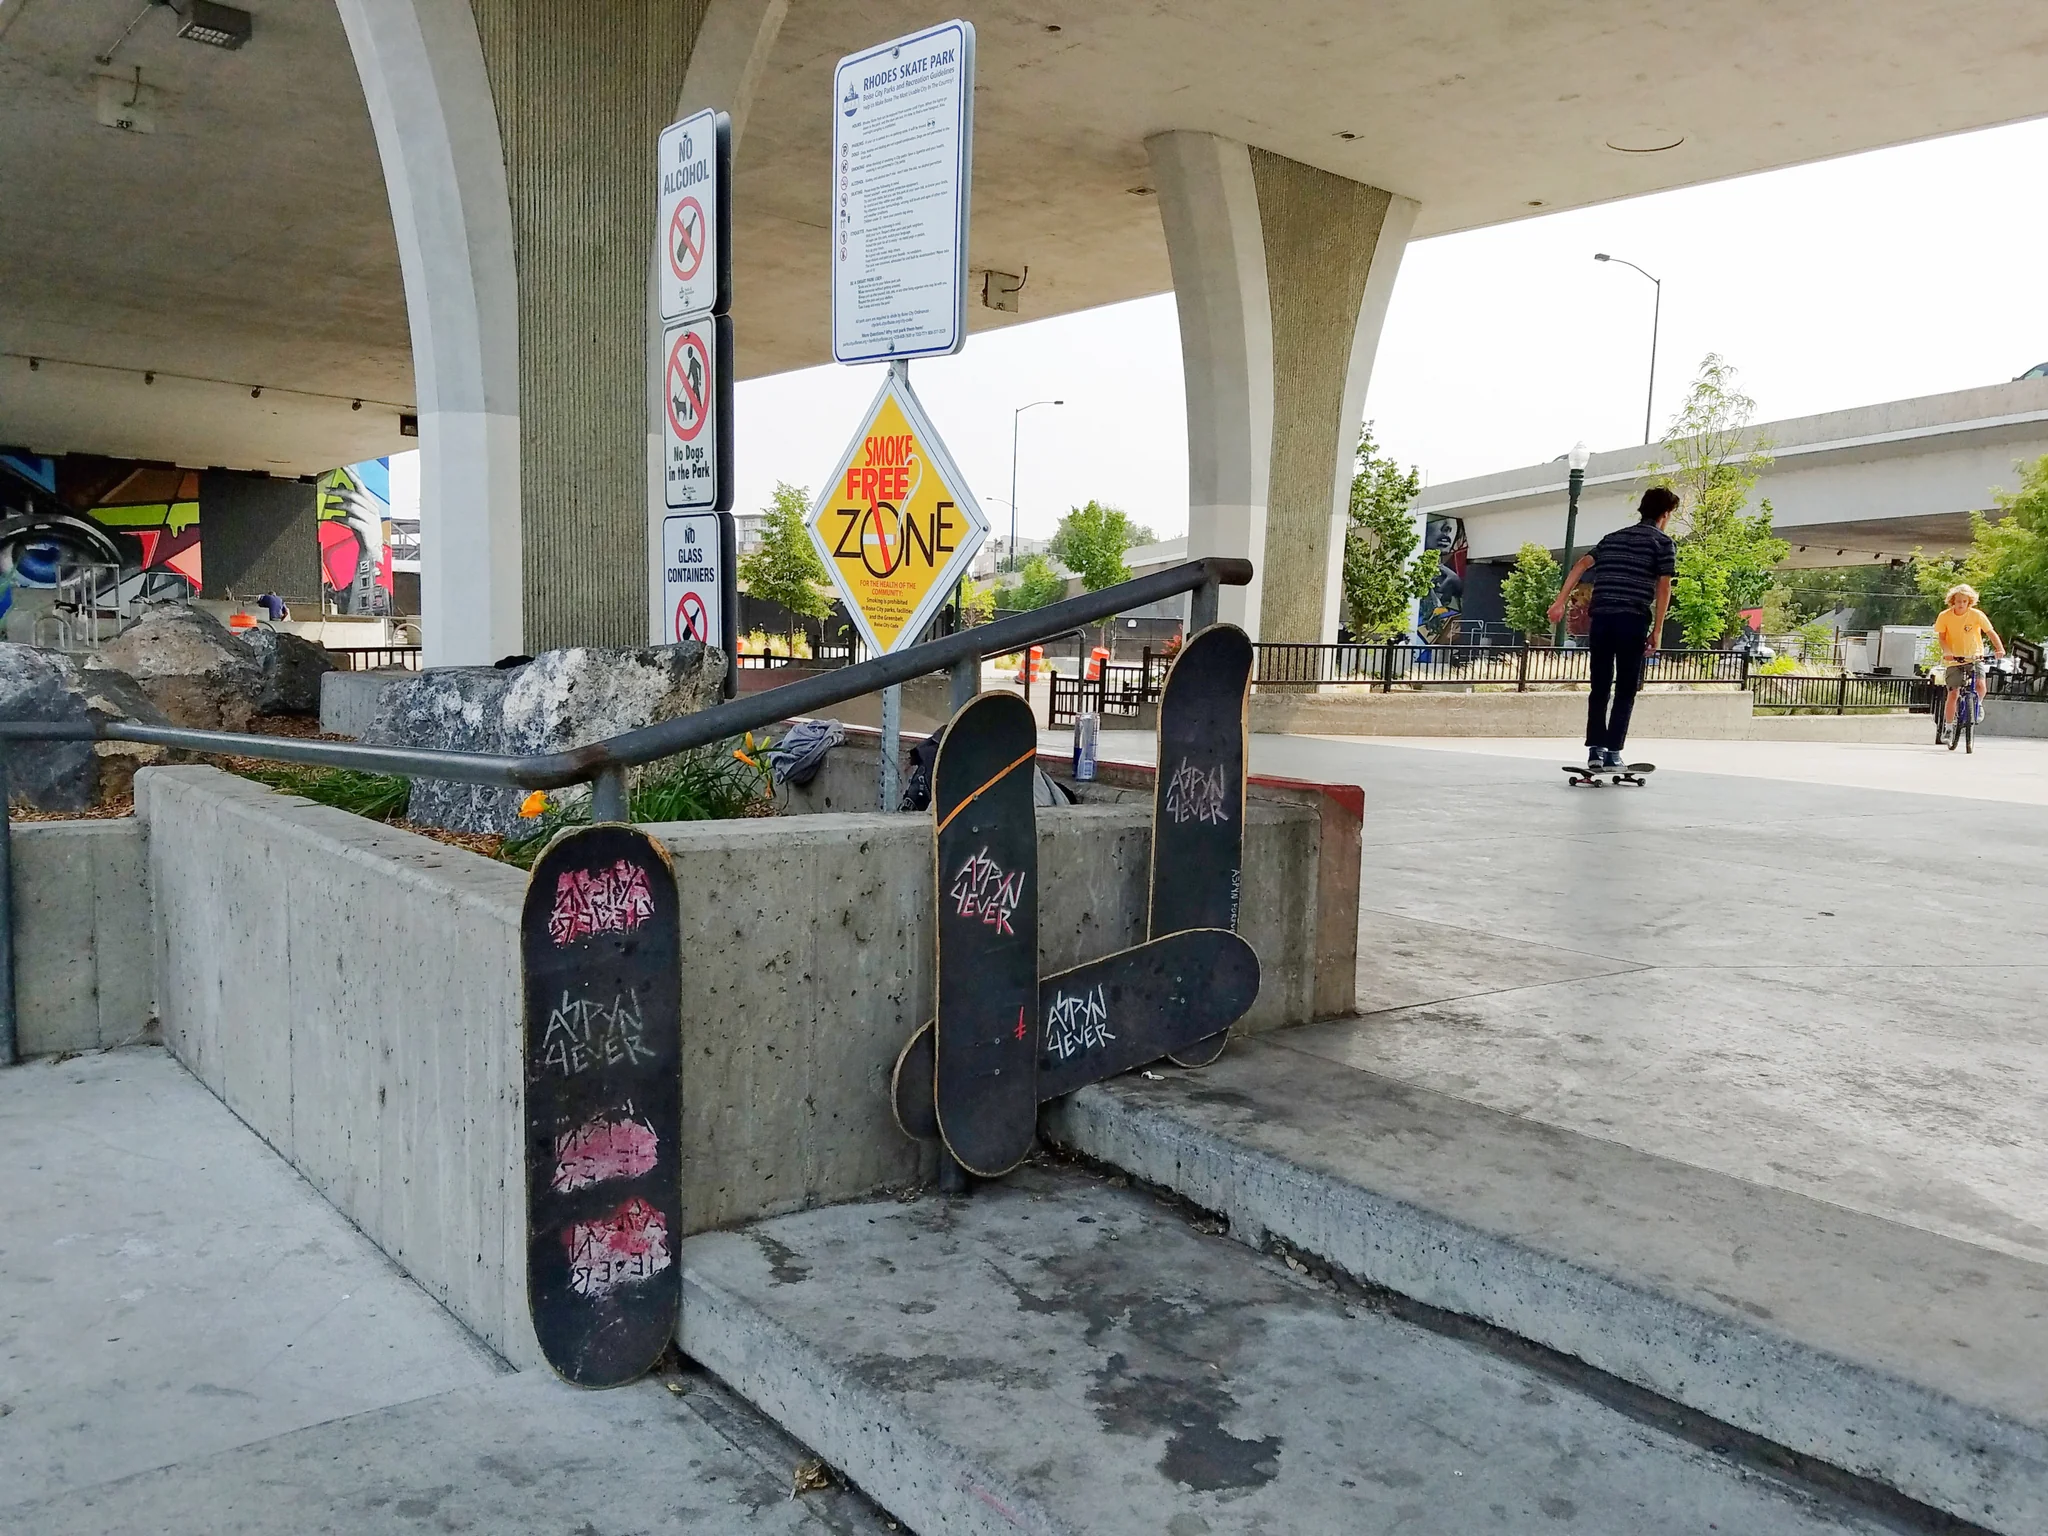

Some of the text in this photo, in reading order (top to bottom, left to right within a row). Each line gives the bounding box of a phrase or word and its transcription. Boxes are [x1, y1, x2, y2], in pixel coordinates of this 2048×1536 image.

[863, 66, 955, 102] Boise City Parks and Recreation Guidelines
[864, 48, 955, 91] RHODES SKATE PARK
[678, 138, 693, 163] NO
[664, 158, 710, 196] ALCOHOL
[674, 444, 704, 462] No Dogs
[865, 435, 912, 466] SMOKE
[668, 464, 710, 481] in the Park
[846, 467, 909, 500] FREE
[684, 528, 696, 544] NO
[833, 502, 954, 578] ZONE
[678, 548, 702, 564] GLASS
[668, 568, 714, 583] CONTAINERS
[870, 580, 879, 588] THE
[880, 581, 898, 589] HEALTH
[906, 582, 916, 590] THE
[866, 597, 883, 605] Smoking
[872, 588, 904, 597] COMMUNITY:
[1166, 756, 1224, 800] ASPYN
[1166, 794, 1229, 825] 4EVER
[955, 846, 1026, 909] ASPYN
[950, 882, 1014, 935] 4EVER
[542, 987, 644, 1048] ASPYN
[1046, 982, 1108, 1038] ASPYN
[545, 1035, 656, 1076] 4EVER
[1048, 1024, 1116, 1059] 4EVER
